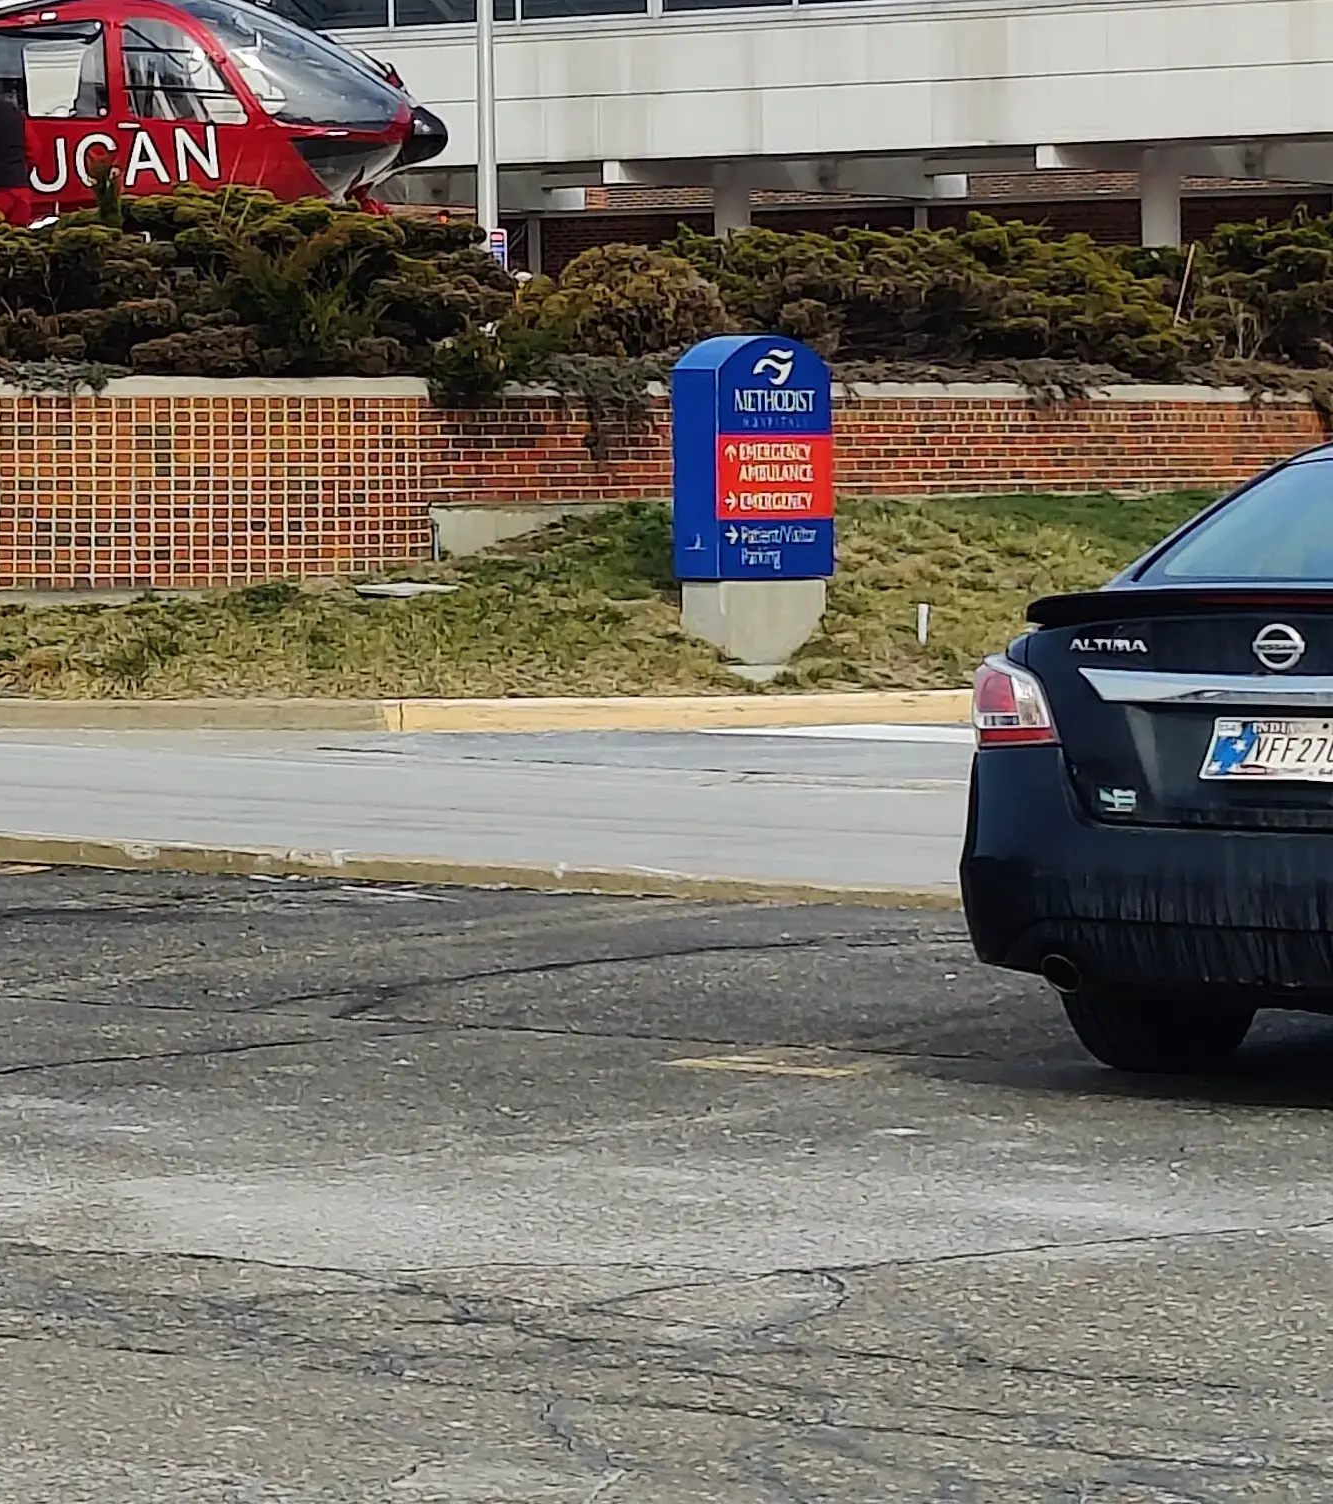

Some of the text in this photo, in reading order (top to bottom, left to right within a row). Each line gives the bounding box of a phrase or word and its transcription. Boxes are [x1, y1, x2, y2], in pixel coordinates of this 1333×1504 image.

[734, 388, 815, 413] METHODIST
[738, 442, 812, 461] EMERGENCY
[738, 463, 815, 483] AMBULANCE
[739, 491, 813, 510] EMERGENCY
[1069, 638, 1149, 653] ALTIMA
